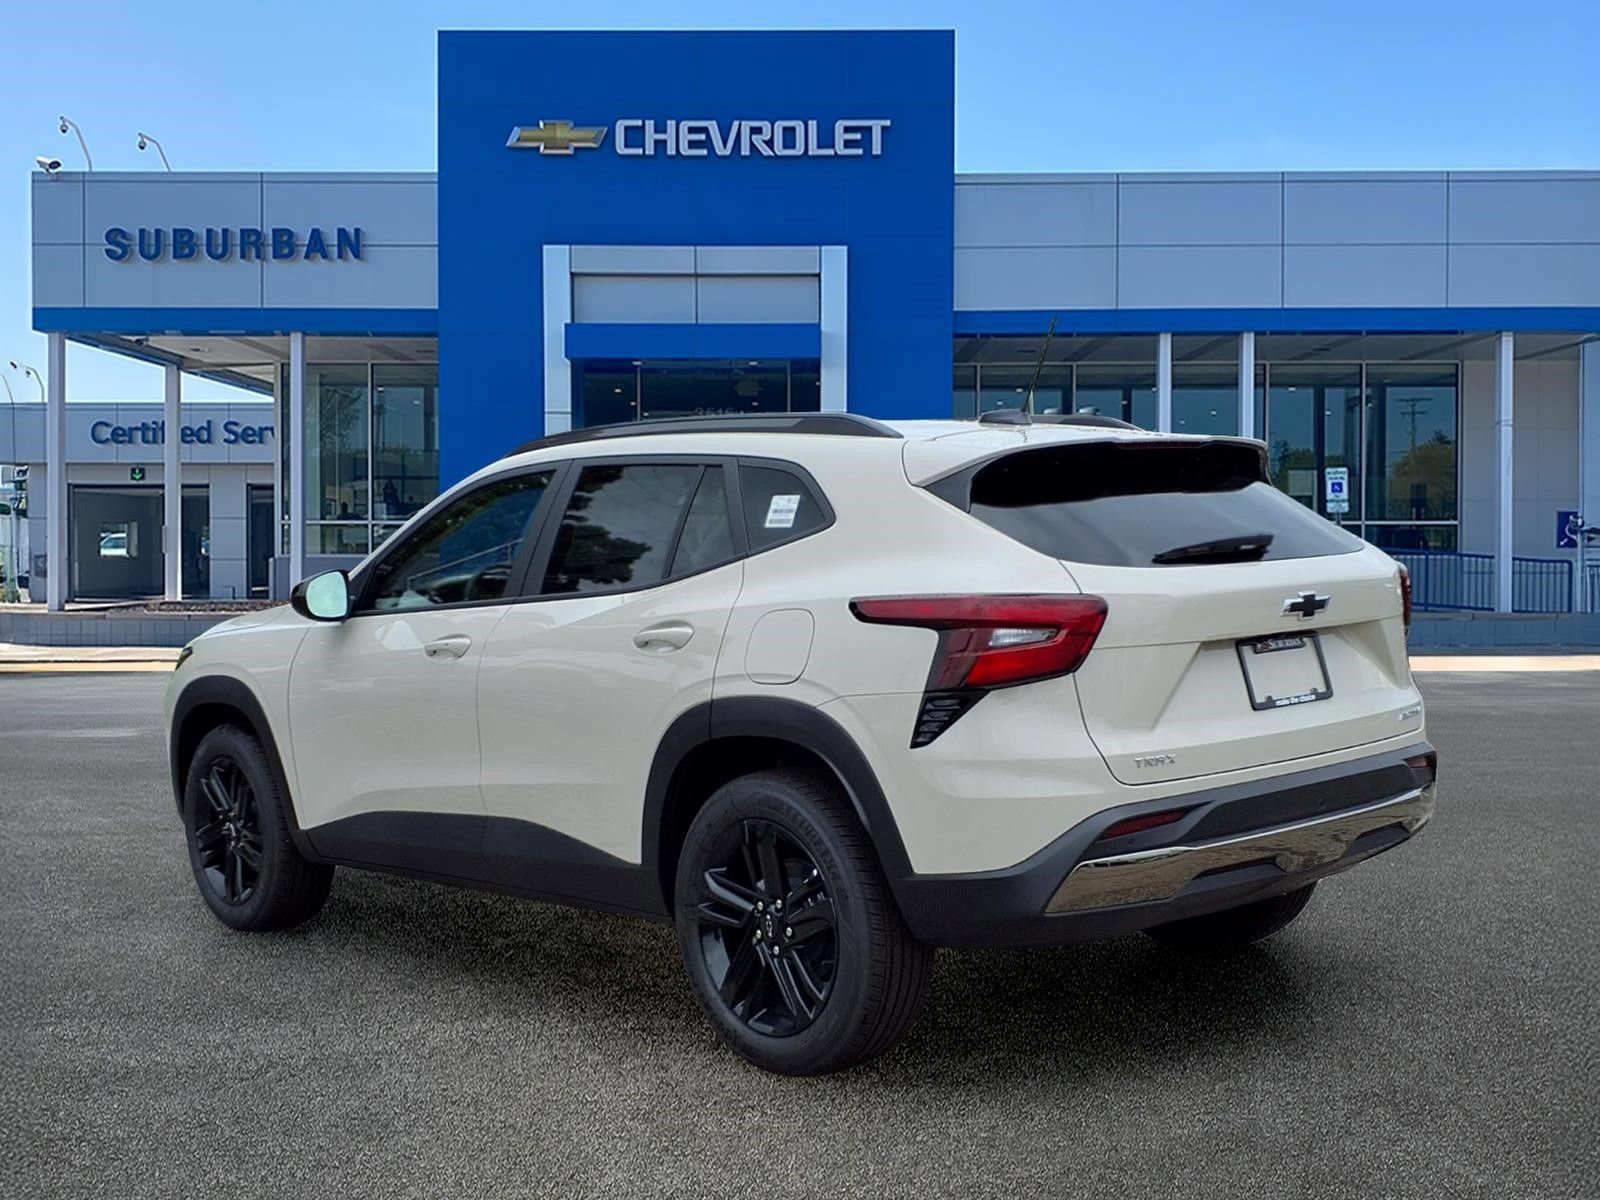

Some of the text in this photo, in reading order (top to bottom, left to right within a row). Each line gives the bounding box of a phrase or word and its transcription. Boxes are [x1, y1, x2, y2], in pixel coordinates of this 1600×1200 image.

[614, 119, 892, 158] CHEVROLET
[104, 227, 363, 262] SUBURBAN
[91, 419, 213, 446] Certifed
